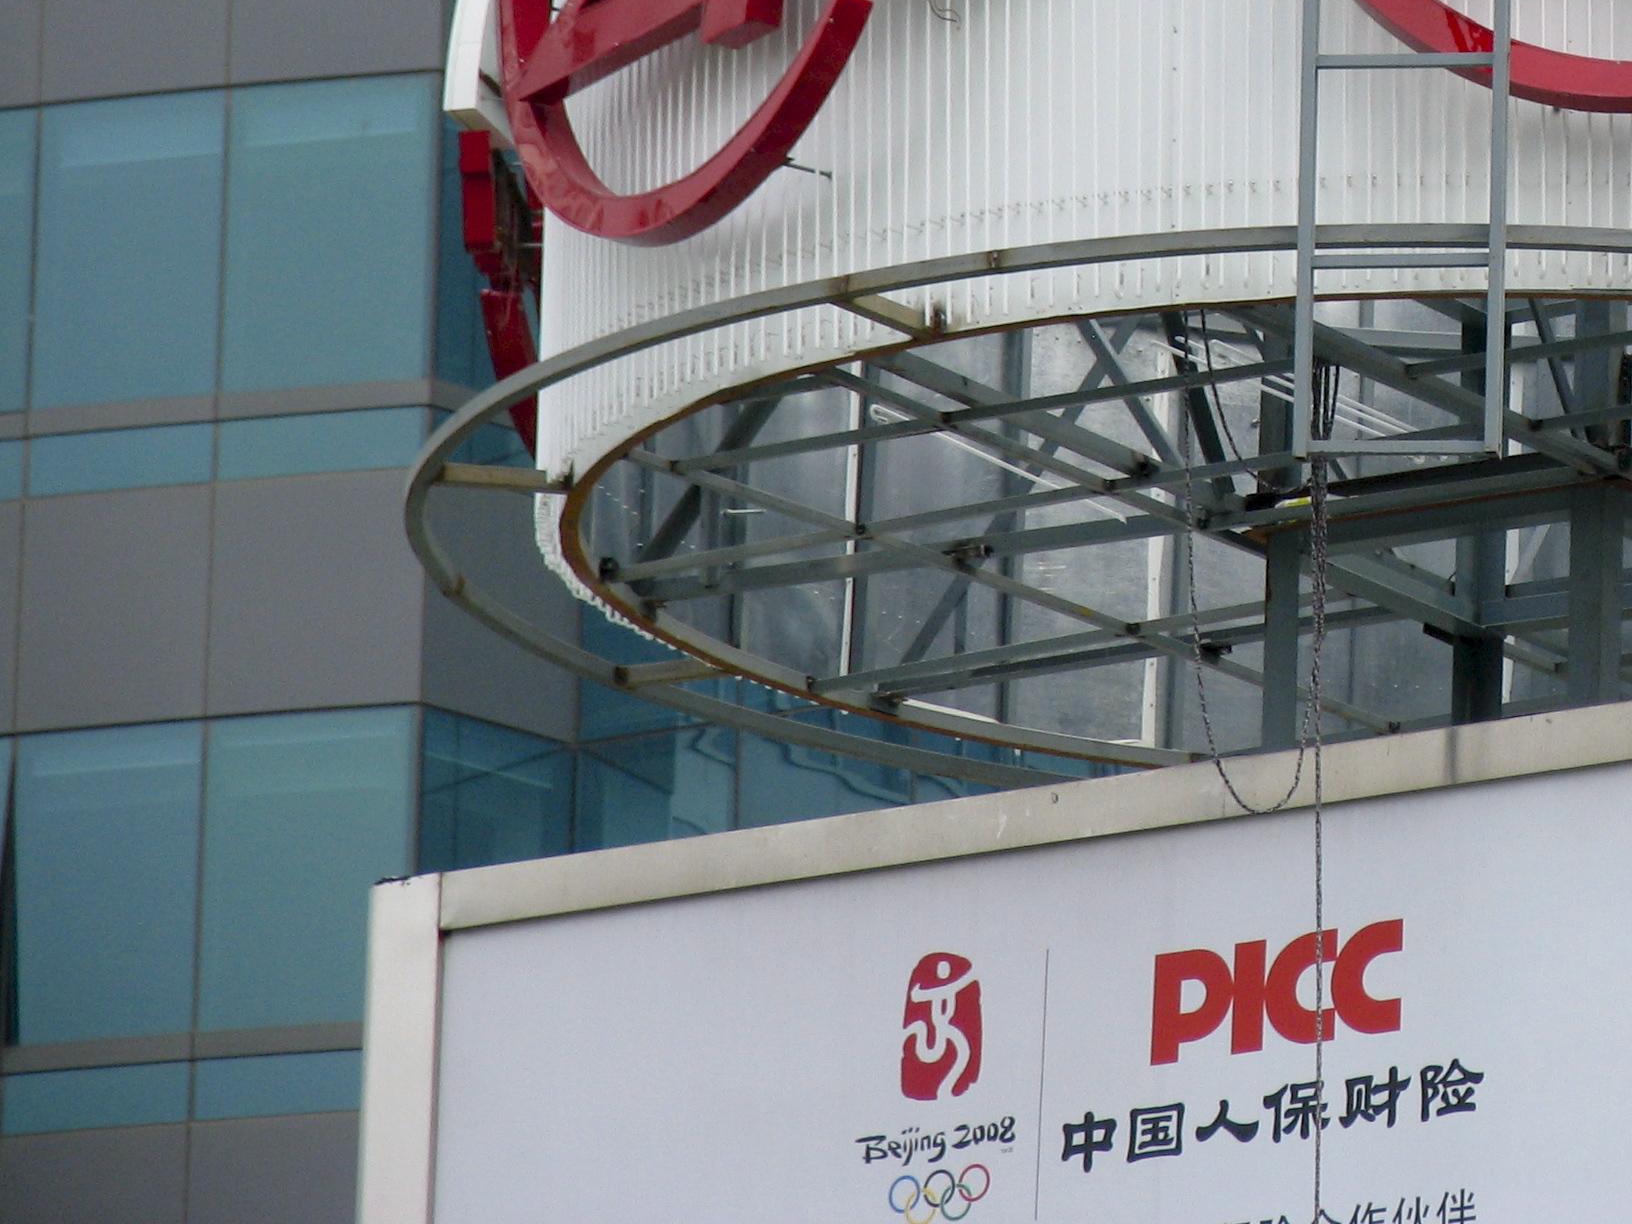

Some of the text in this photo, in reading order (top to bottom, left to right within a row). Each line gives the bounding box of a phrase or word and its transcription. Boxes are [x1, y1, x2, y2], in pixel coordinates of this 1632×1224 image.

[1150, 918, 1404, 1066] PICC
[855, 1116, 1016, 1166] Beijing 2008
[1061, 1058, 1485, 1173] 中国人保财险
